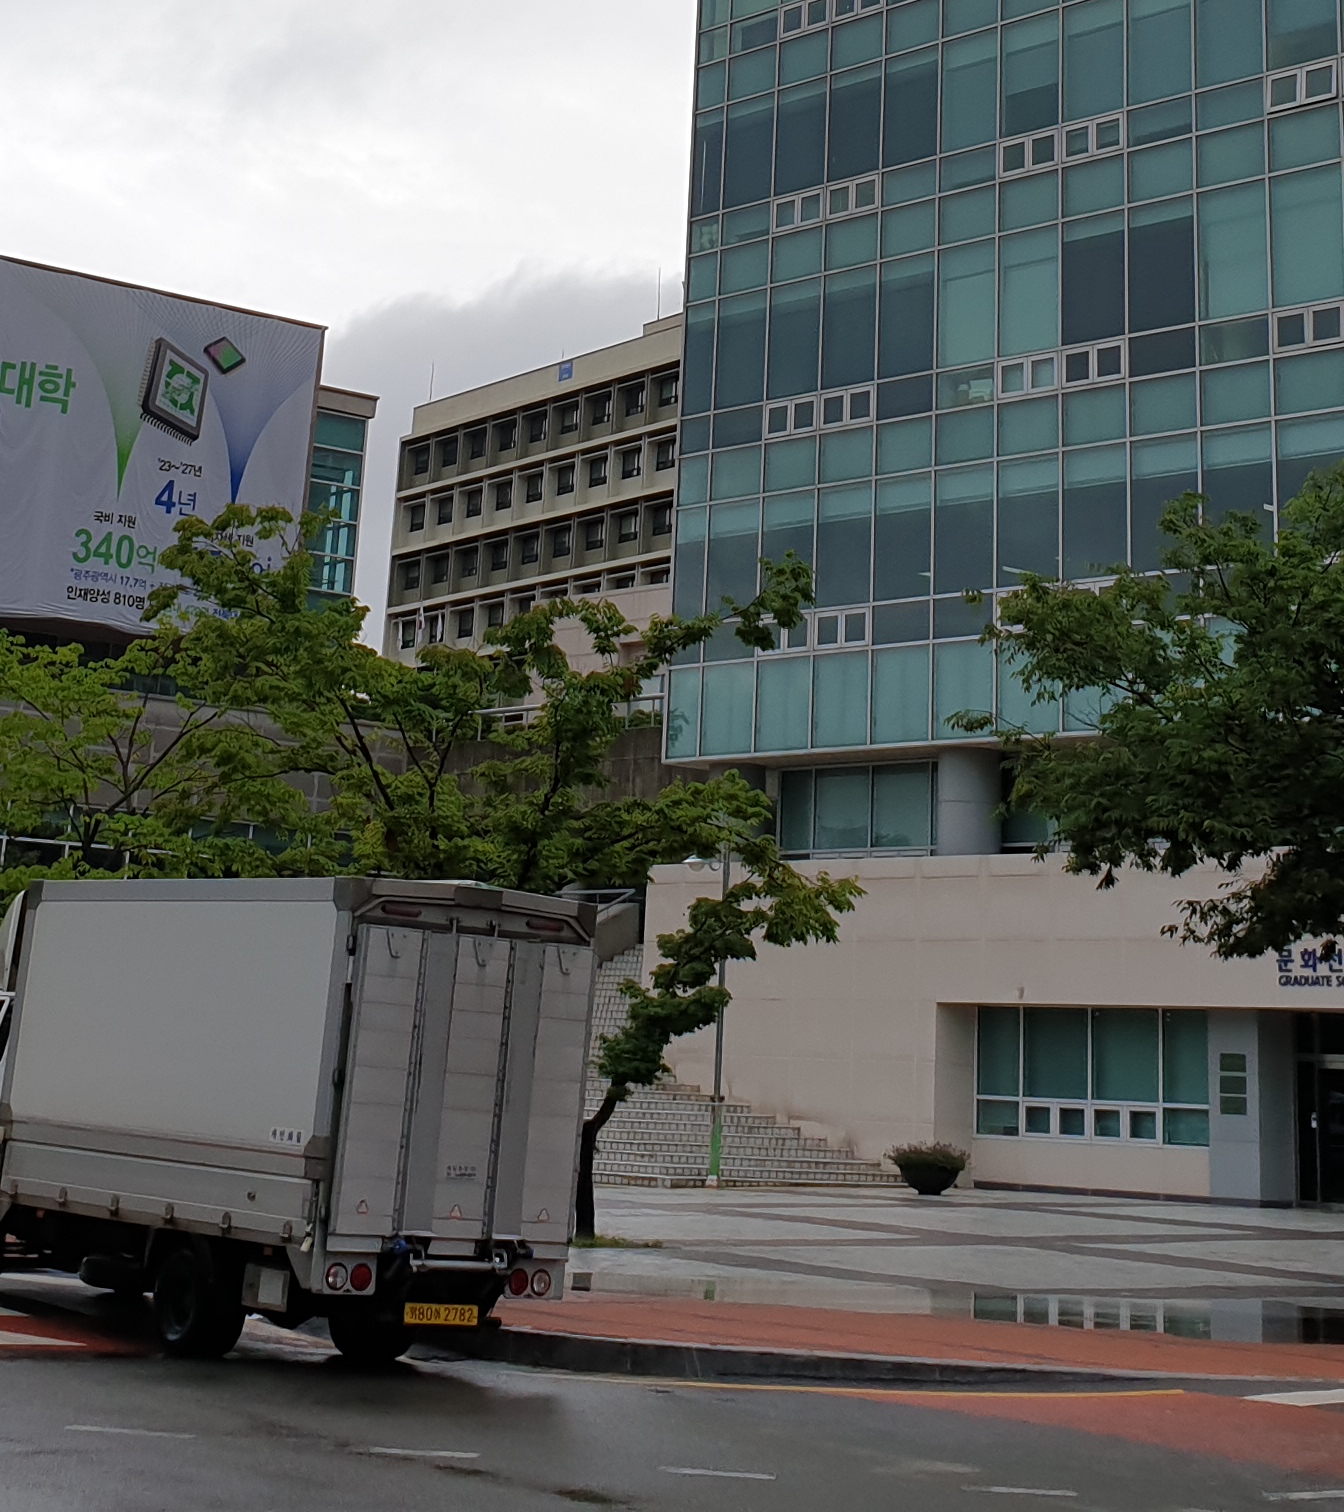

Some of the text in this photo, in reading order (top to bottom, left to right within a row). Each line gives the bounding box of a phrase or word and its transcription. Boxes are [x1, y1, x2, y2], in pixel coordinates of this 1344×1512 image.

[155, 480, 196, 516] 4년
[94, 511, 136, 529] 국비 지원
[72, 529, 157, 573] 340억
[67, 586, 145, 609] 인재양성 810명
[1278, 975, 1332, 987] GRADUATE
[444, 1307, 474, 1323] 2782
